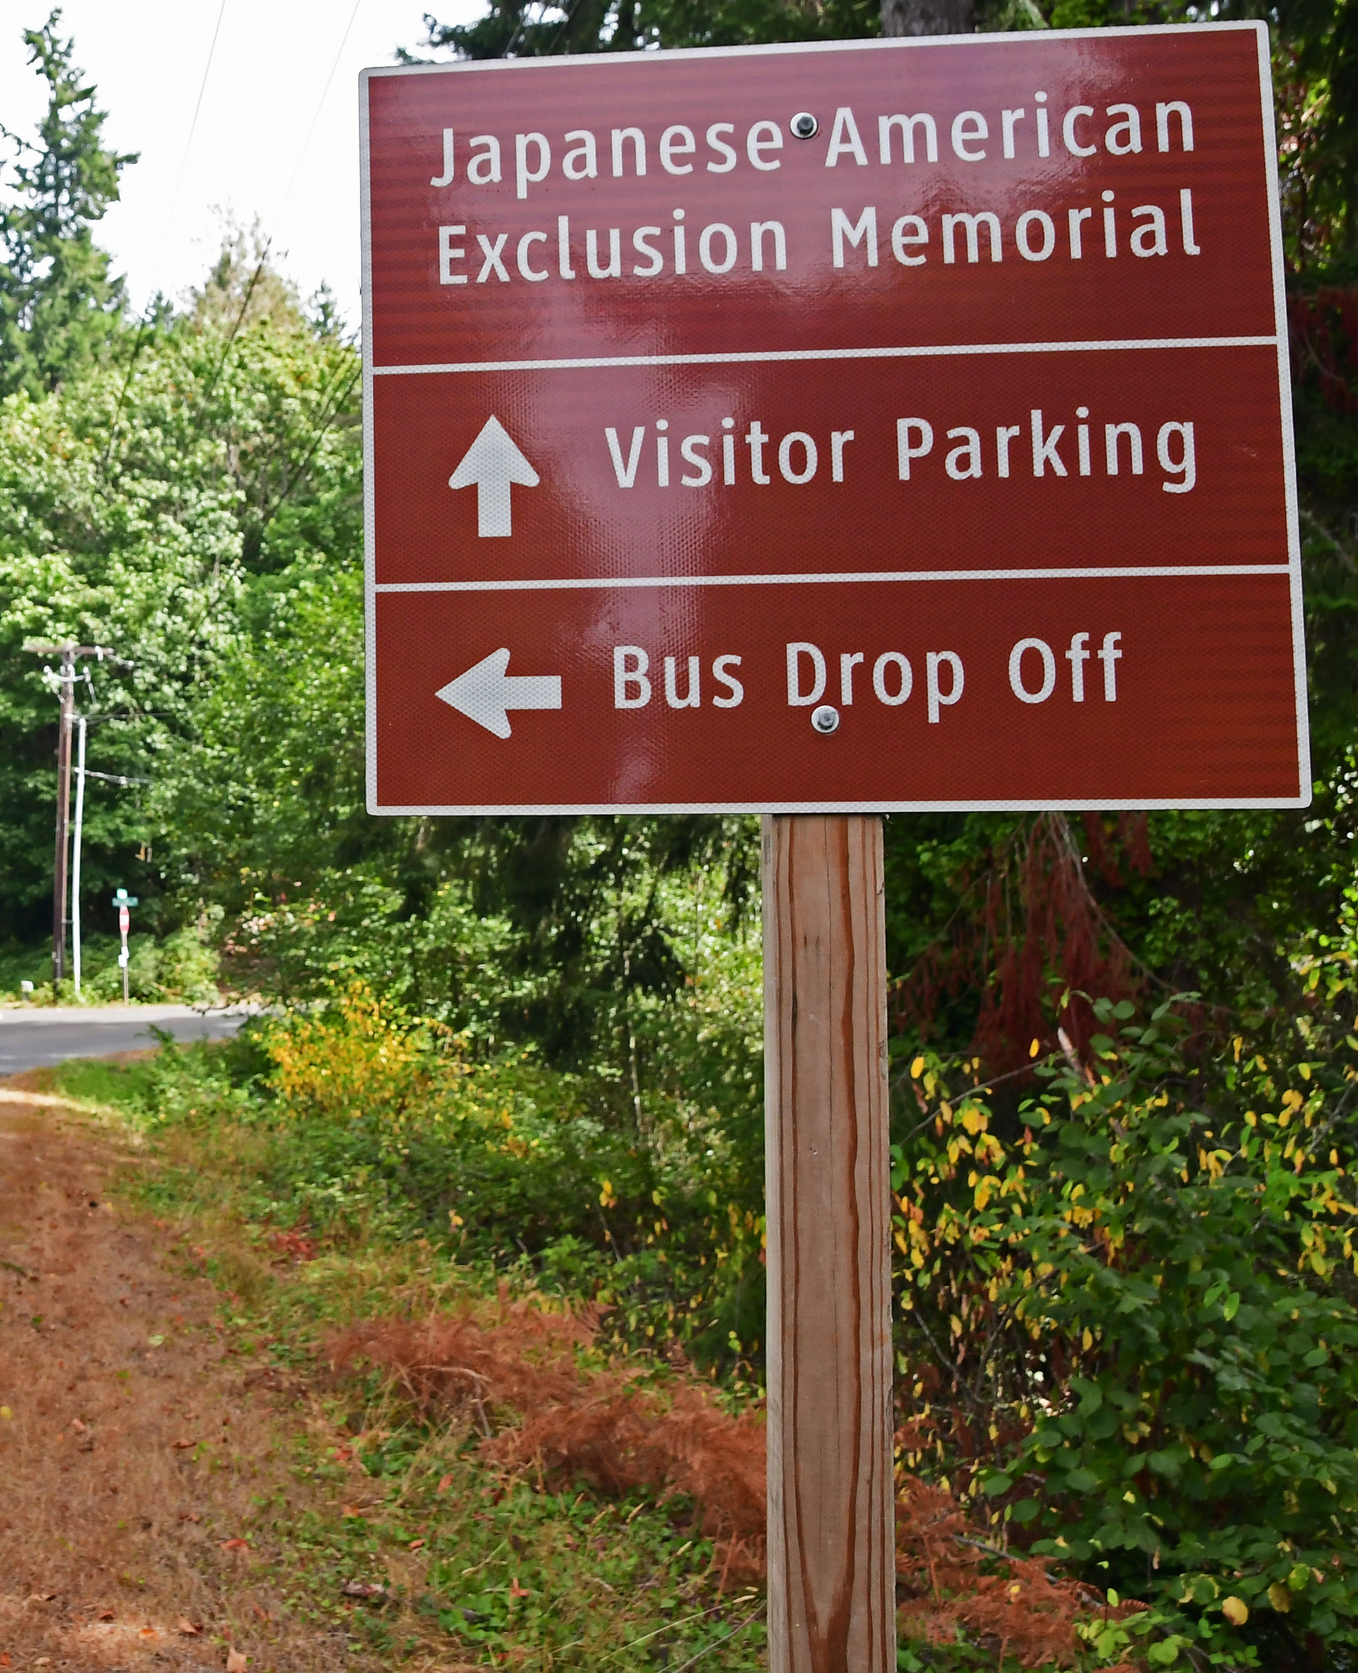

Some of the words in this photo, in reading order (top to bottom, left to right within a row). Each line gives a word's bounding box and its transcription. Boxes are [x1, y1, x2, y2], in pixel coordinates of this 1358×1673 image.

[430, 120, 784, 200] Japanese
[824, 90, 1194, 167] American
[438, 208, 787, 285] Exclusion
[831, 188, 1201, 268] Memorial
[604, 417, 854, 488] Visitor
[896, 406, 1196, 494] Parking
[613, 645, 744, 709] Bus
[786, 642, 964, 723] Drop
[1008, 631, 1122, 704] Off
